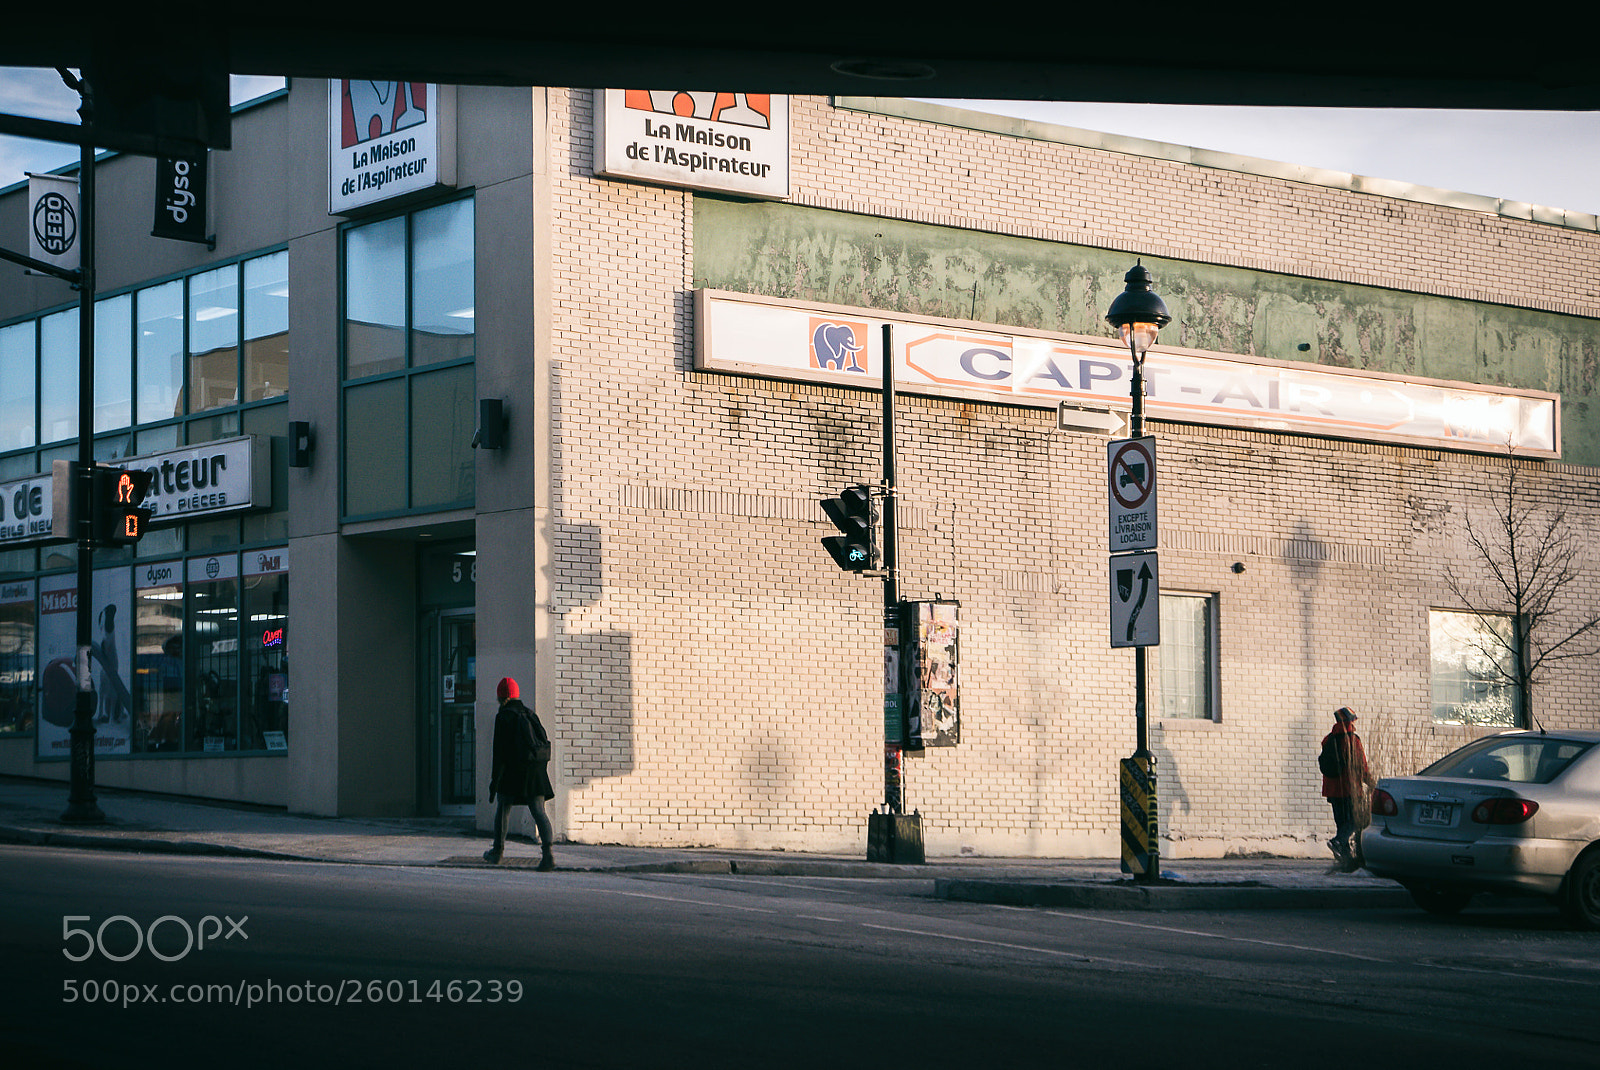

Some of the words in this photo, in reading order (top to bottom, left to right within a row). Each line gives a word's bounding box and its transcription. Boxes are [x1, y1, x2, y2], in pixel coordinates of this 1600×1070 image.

[645, 118, 671, 140] La
[674, 123, 751, 152] Maison
[353, 150, 369, 170] La
[370, 135, 416, 164] Maison
[626, 142, 650, 162] de
[654, 144, 771, 178] l'Aspirateur
[341, 176, 356, 196] de
[357, 155, 428, 193] l'Aspirateur
[47, 196, 63, 251] SEBO
[14, 485, 42, 520] de
[1115, 522, 1152, 534] LIVRAISON
[1120, 533, 1146, 543] LOCALE
[147, 565, 172, 585] dyson
[42, 592, 77, 611] Miele
